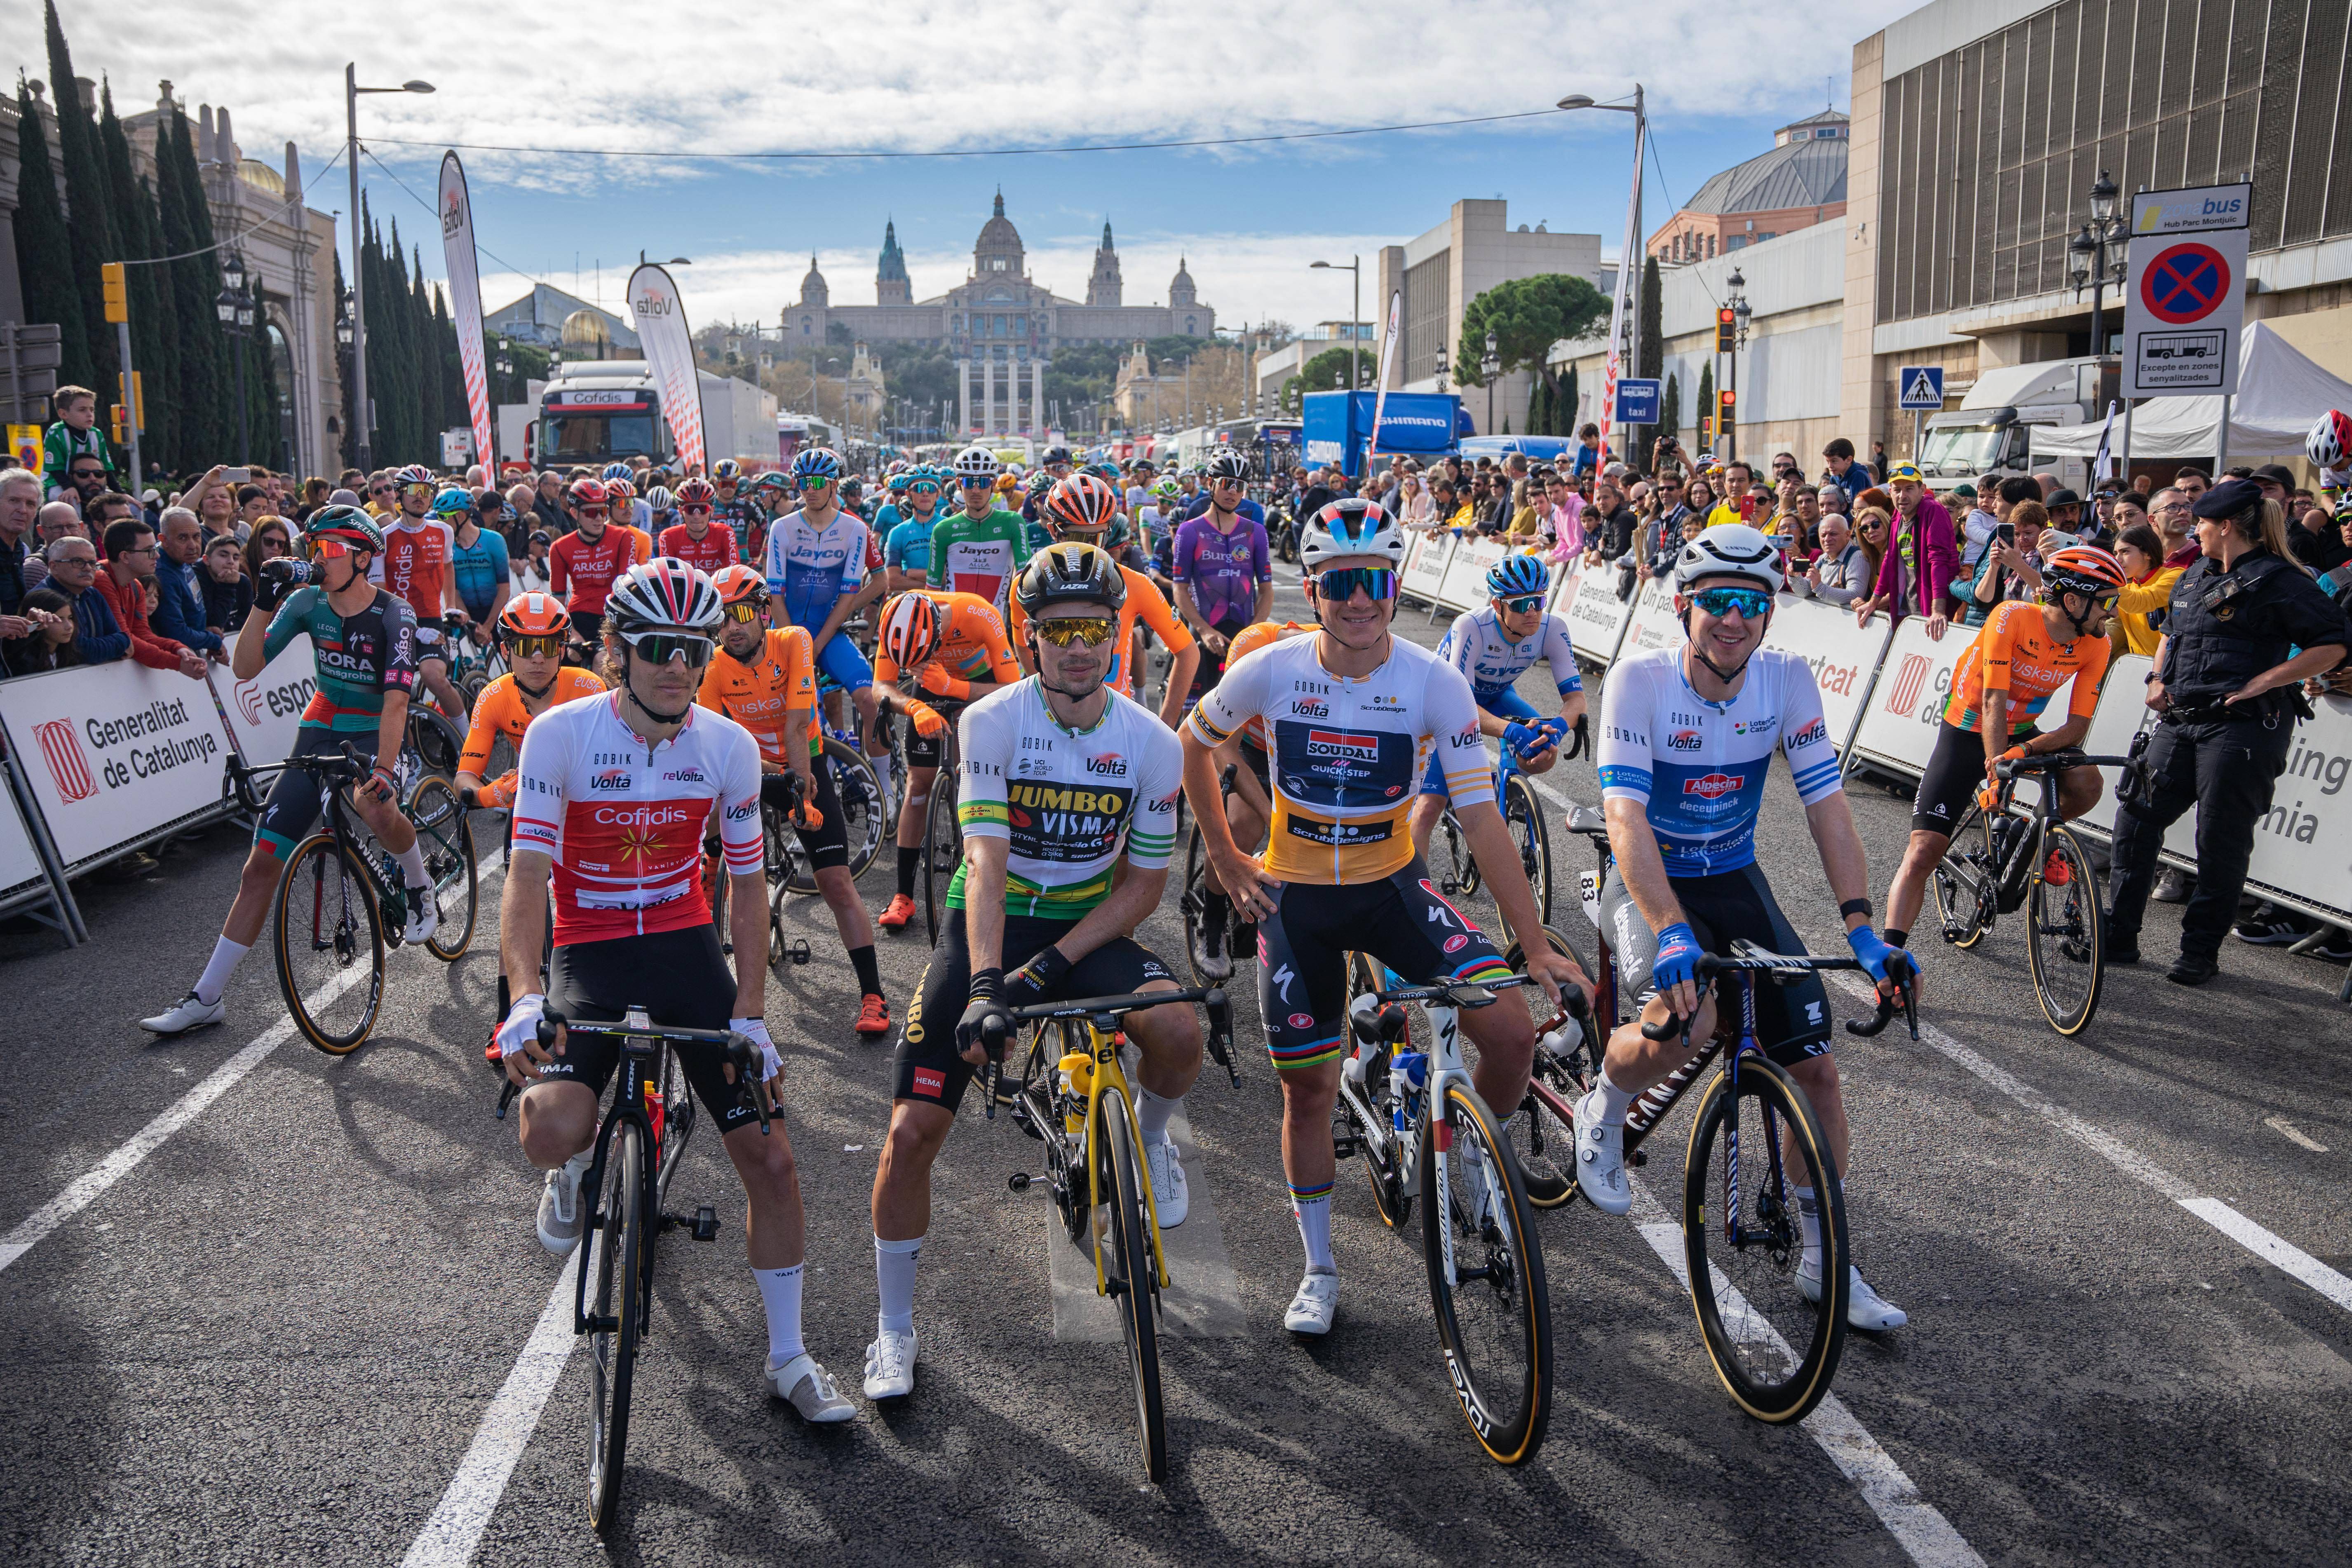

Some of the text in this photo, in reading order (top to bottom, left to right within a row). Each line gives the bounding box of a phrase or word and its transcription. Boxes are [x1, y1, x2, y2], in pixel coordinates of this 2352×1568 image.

[2162, 197, 2241, 219] zonabus
[2202, 216, 2237, 225] Montjuïc
[2149, 374, 2209, 383] senyalitzades
[574, 392, 622, 404] Cofidis
[1628, 407, 1646, 417] taxi
[1378, 416, 1446, 427] SHIMANO
[347, 518, 384, 551] SPECIALIZED
[727, 530, 737, 566] ARKEA
[774, 536, 782, 575] GIANT
[790, 545, 844, 562] Jayco
[851, 536, 862, 575] GIANT
[959, 546, 1000, 555] Jayco
[573, 559, 613, 572] ARKEA
[1094, 559, 1105, 582] JUMBO
[1043, 567, 1054, 583] VISMA
[1580, 581, 1618, 606] Generalitat
[1642, 586, 1657, 605] Un
[967, 604, 1004, 638] euskaltel
[1572, 602, 1617, 632] de Catalunya
[326, 624, 337, 633] COL
[1641, 627, 1664, 640] Generalitat
[392, 627, 411, 666] XBO
[782, 626, 811, 668] euskaltel
[2016, 644, 2038, 660] ORBEA
[318, 648, 376, 672] BORA
[320, 664, 374, 682] hansgrohe
[1957, 646, 1979, 699] ORBEA
[1295, 681, 1329, 695] GOBIK
[472, 683, 502, 730] euskaltel
[1292, 702, 1328, 717] Volta
[1361, 705, 1406, 714] ScrubDesigns
[1922, 700, 1941, 727] de
[87, 697, 189, 750] Generalitat
[1671, 712, 1703, 727] GOBIK
[1023, 737, 1052, 751] GOBIK
[1607, 726, 1648, 747] GOBIK
[1667, 734, 1702, 749] Volta
[1788, 725, 1826, 750] Volta
[104, 731, 218, 789] de Catalunya
[594, 753, 631, 765] GOBIK
[1308, 743, 1376, 761] SOUDAL
[1086, 758, 1126, 775] Volta
[592, 775, 631, 789] Volta
[663, 770, 704, 782] reVolta
[1690, 778, 1737, 792] Alpecin
[522, 775, 561, 798] GOBIK
[1008, 785, 1122, 814] JUMBO
[1680, 797, 1739, 812] deceuninck
[595, 807, 688, 825] Cofidis
[727, 798, 760, 820] Volta
[853, 764, 876, 859] CADEX
[1927, 811, 1949, 820] ETXEONDO
[1042, 812, 1115, 835] VISMA
[522, 827, 556, 841] reVolta
[1293, 826, 1385, 844] ScrubDesigns
[816, 844, 844, 853] ORBEA
[1010, 845, 1033, 854] KODA
[1041, 839, 1088, 849] cervélo
[671, 855, 691, 867] RYSEL
[1580, 877, 1595, 902] 83
[1614, 901, 1643, 984] deceuninck
[1738, 957, 1812, 968] CANYON
[1022, 968, 1046, 986] JUMBO
[1025, 977, 1040, 991] VISMA
[363, 972, 381, 1030] roval
[1399, 991, 1427, 1000] PRO
[1054, 1009, 1086, 1017] cervélo
[571, 1024, 613, 1032] LOOK
[757, 1040, 773, 1049] fidis
[1222, 1034, 1239, 1076] SRAM
[627, 1059, 635, 1100] LOOK
[916, 1076, 941, 1089] HEMA
[987, 1063, 996, 1108] SRAM
[1436, 1166, 1449, 1262] SPECIALIZED
[1444, 1349, 1490, 1439] roval
